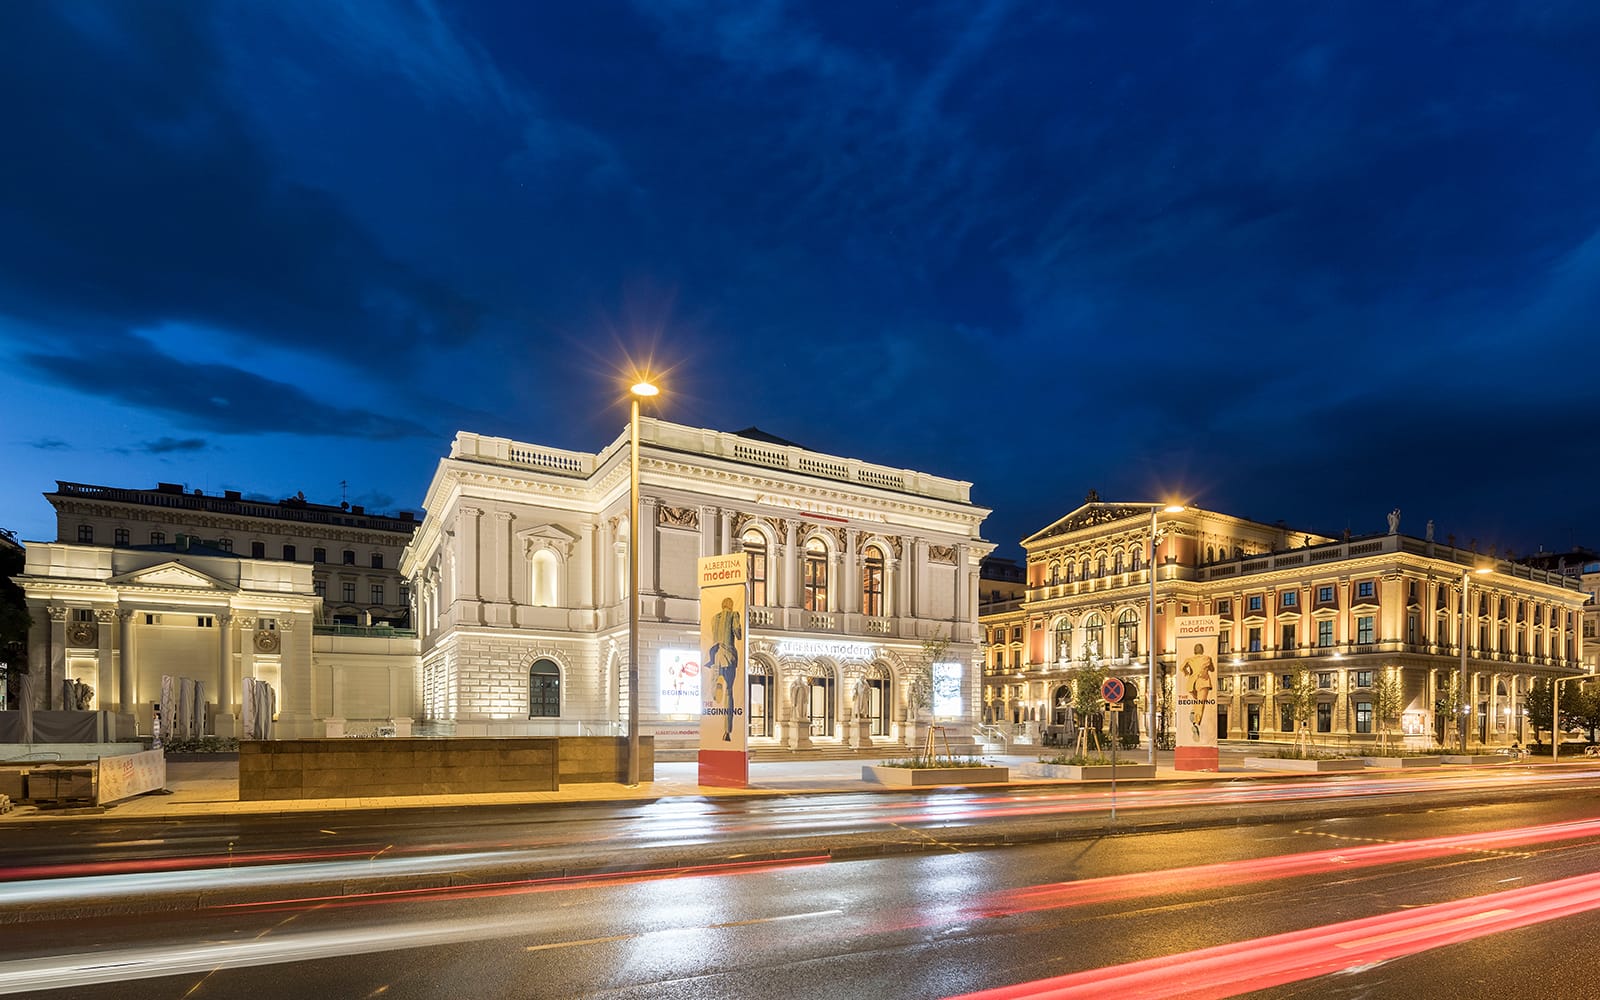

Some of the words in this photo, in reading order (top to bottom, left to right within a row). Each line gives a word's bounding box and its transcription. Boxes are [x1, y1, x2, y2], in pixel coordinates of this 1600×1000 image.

[704, 560, 740, 571] ALBERTINA
[703, 569, 741, 581] modern
[662, 689, 700, 697] BEGINNING
[703, 708, 743, 716] BEGINNING
